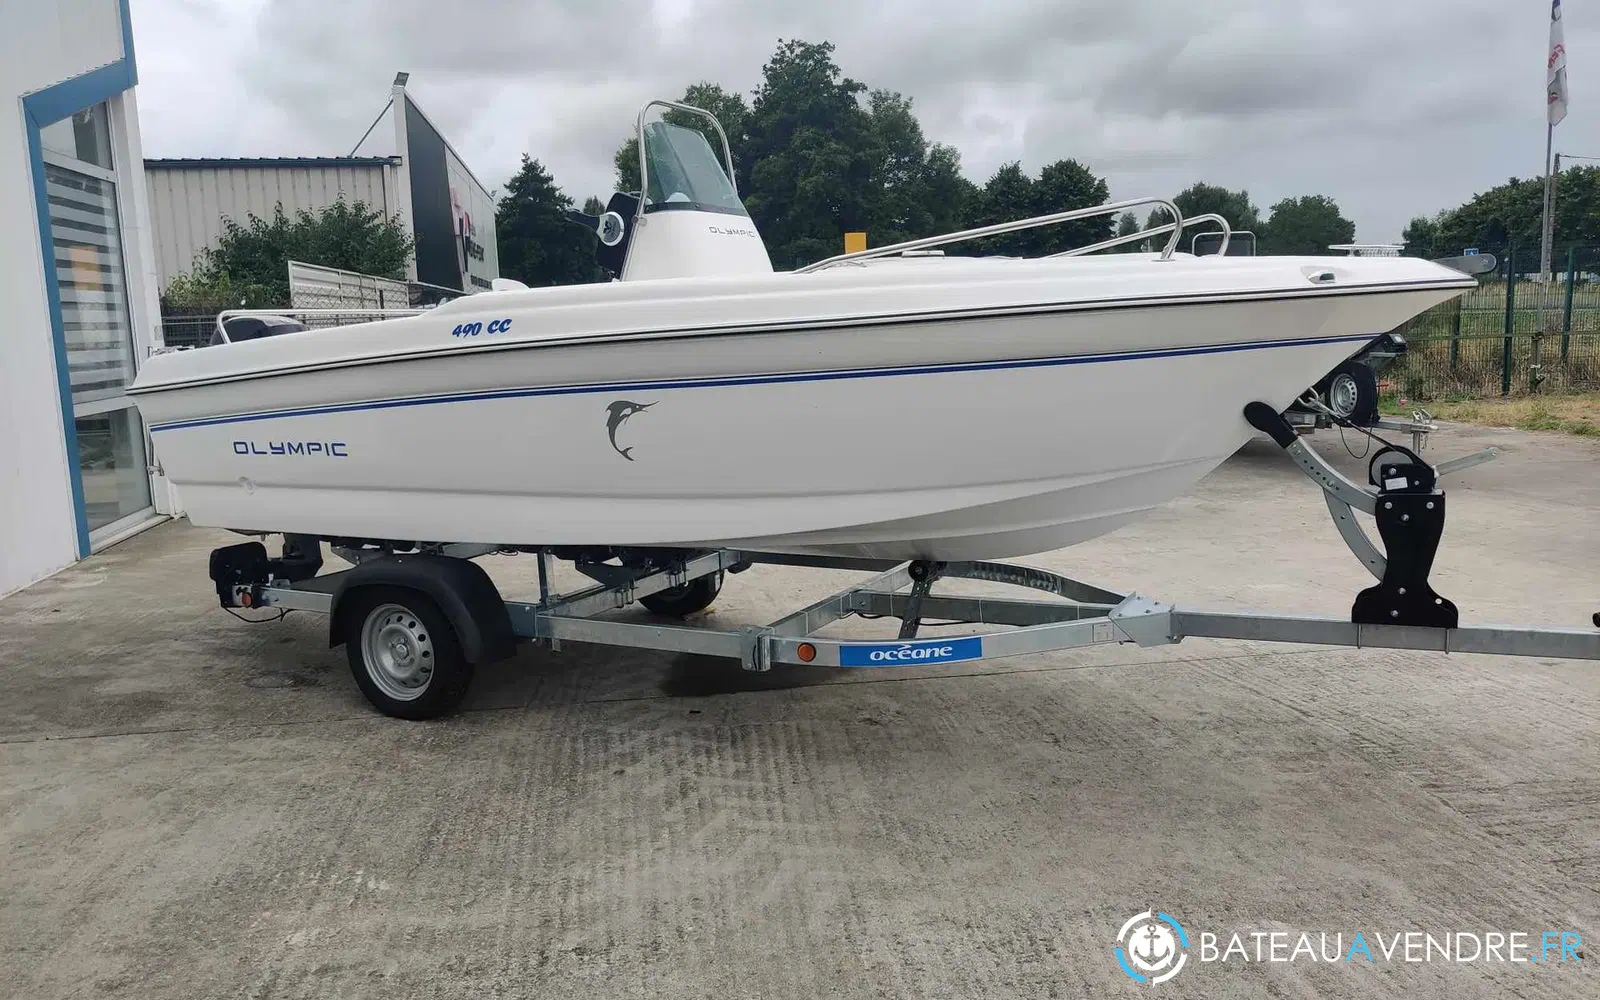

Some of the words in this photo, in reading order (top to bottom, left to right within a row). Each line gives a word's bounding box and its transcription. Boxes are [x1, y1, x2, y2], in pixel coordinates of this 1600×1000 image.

[709, 226, 755, 238] OLYMPIC
[452, 322, 482, 338] 490
[487, 318, 512, 334] CC
[233, 441, 348, 456] OLYMPIC
